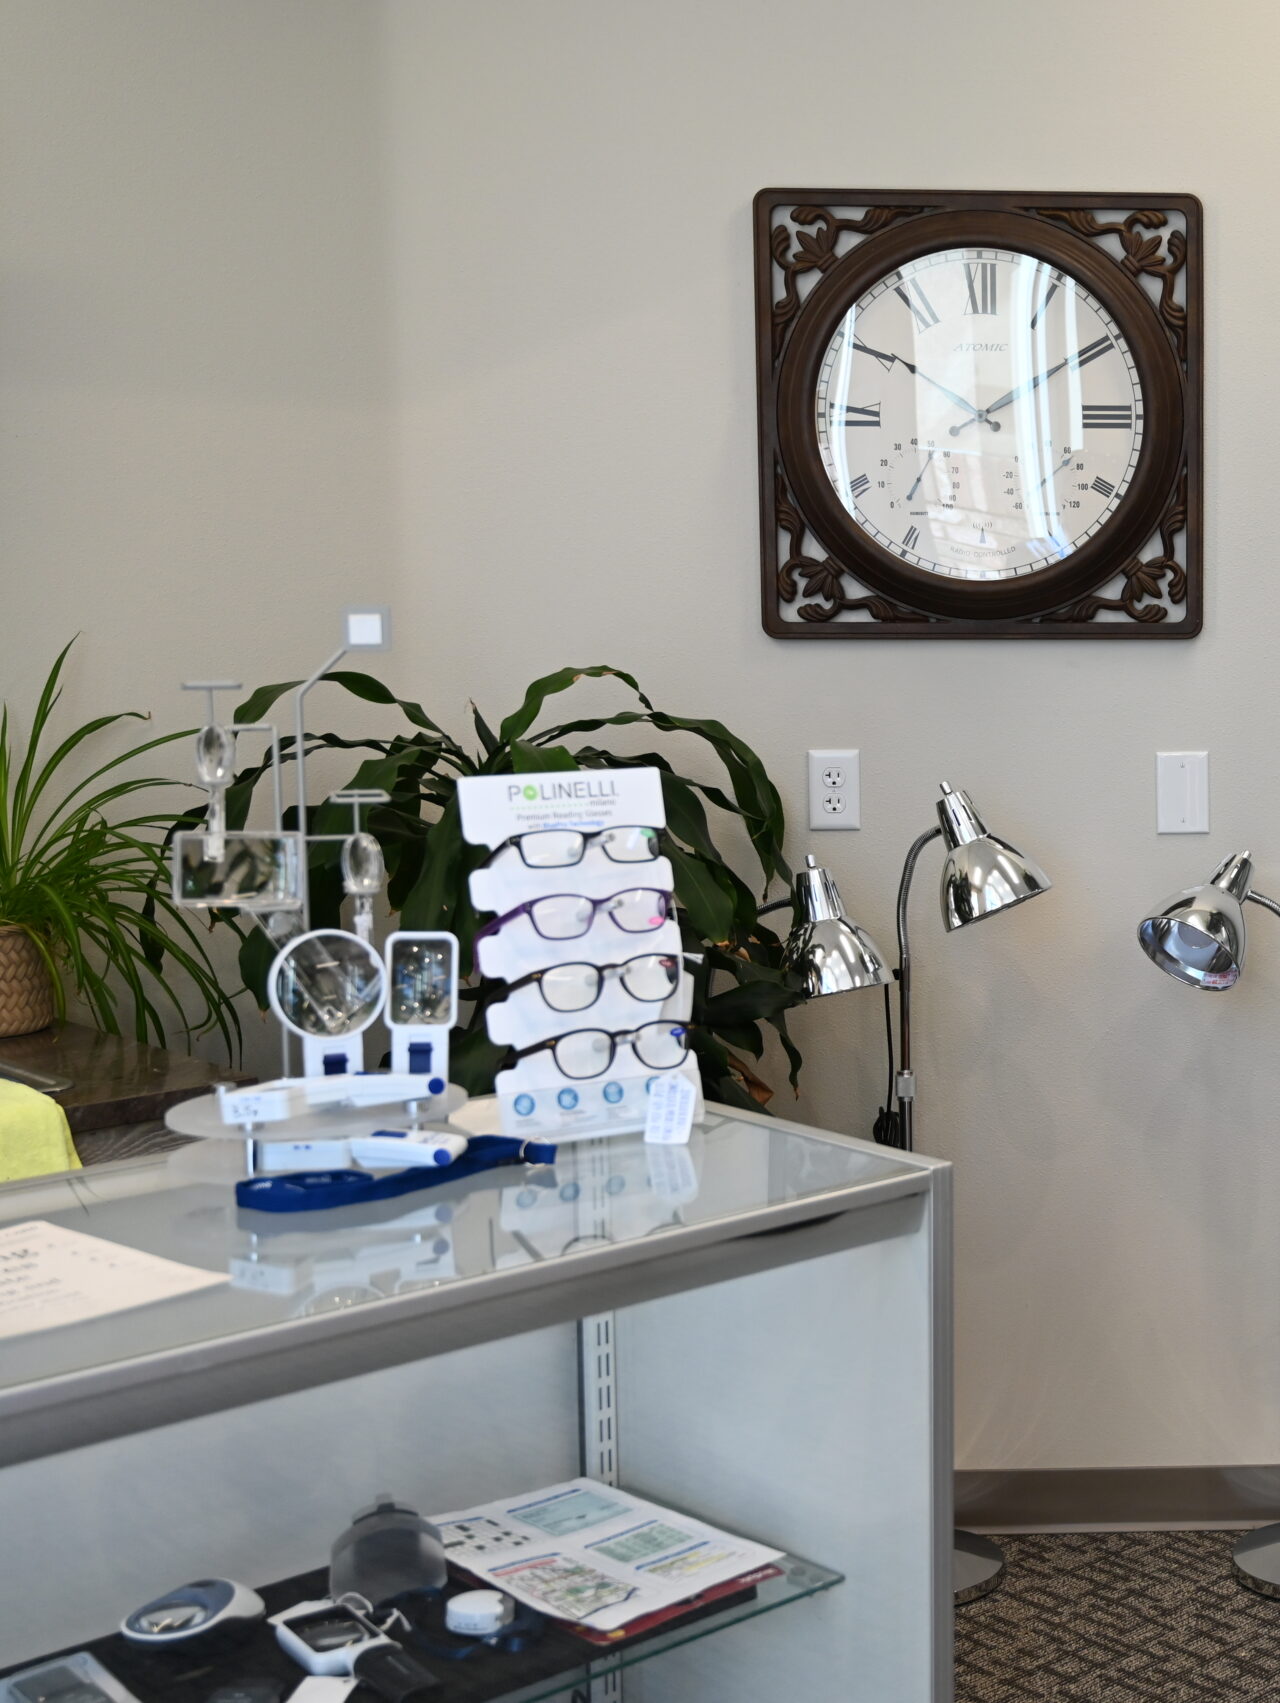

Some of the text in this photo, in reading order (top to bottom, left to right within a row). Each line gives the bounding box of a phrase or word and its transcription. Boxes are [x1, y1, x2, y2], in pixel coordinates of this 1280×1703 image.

[962, 262, 998, 316] XII
[953, 343, 1009, 352] ATOMIC
[1081, 404, 1133, 430] III
[910, 438, 919, 446] 40
[893, 443, 902, 451] 30
[880, 459, 889, 467] 20
[877, 481, 886, 489] 10
